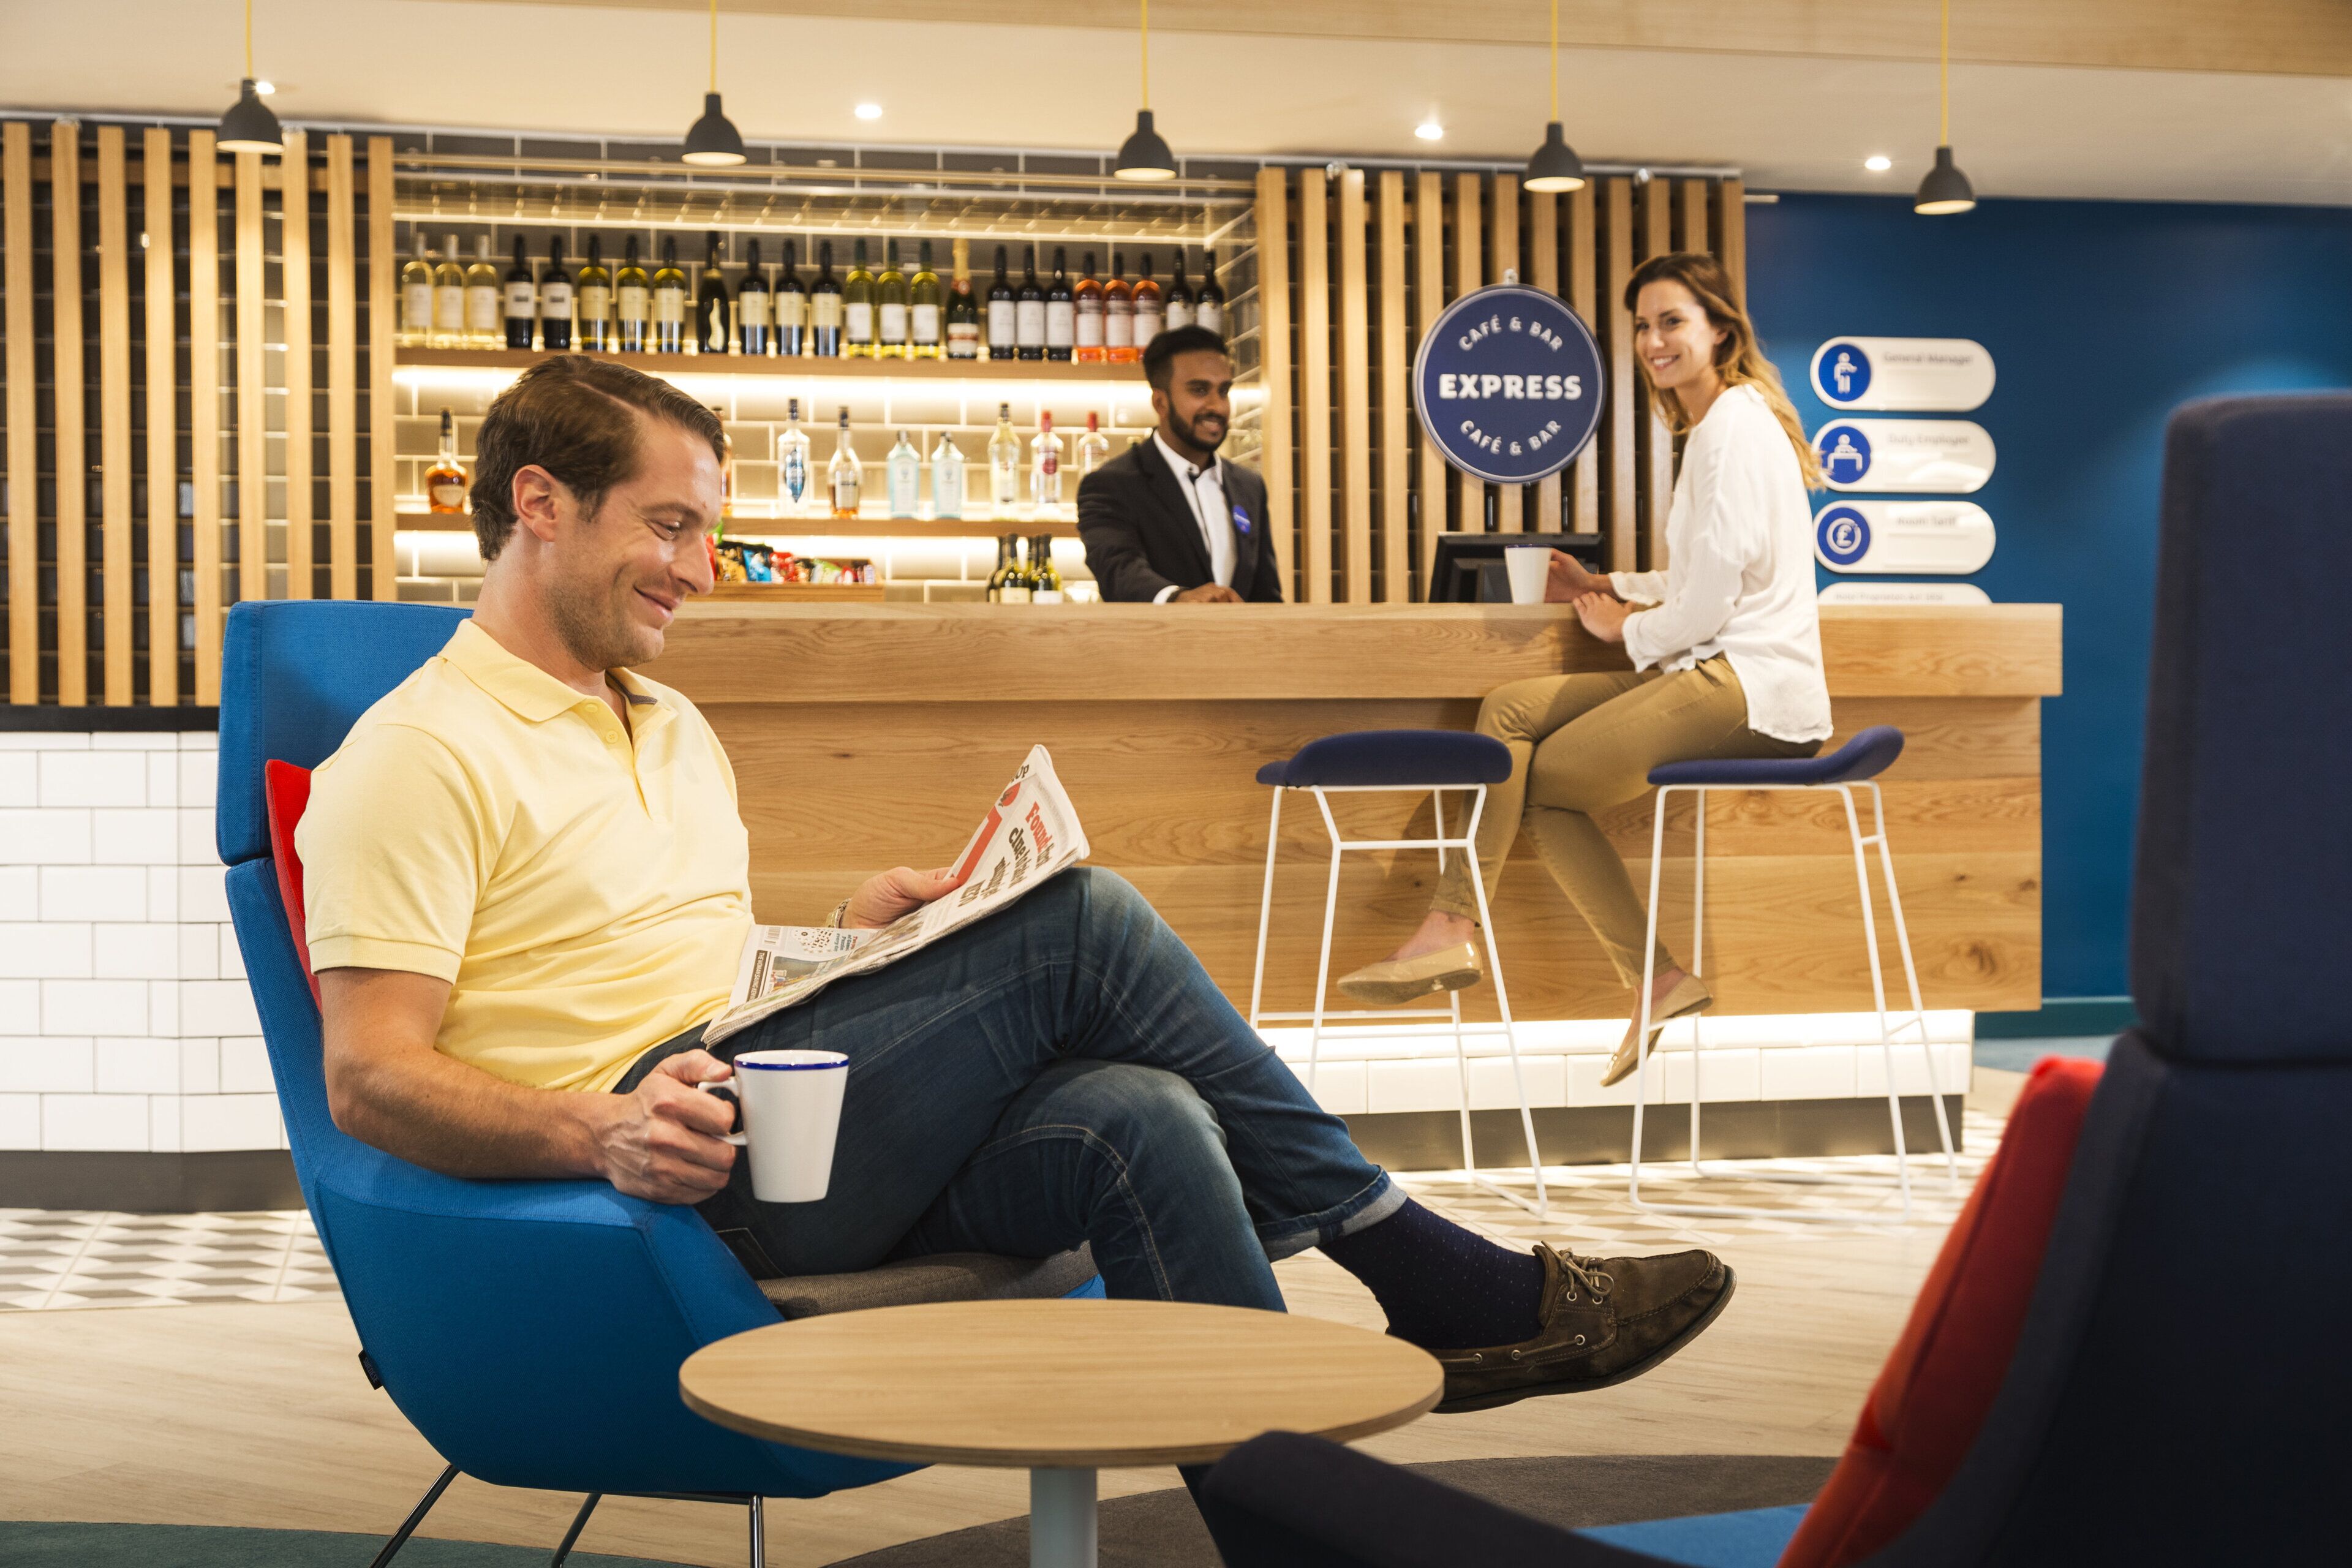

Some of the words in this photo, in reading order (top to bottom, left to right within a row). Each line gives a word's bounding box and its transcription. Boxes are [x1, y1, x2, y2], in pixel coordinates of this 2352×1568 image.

[1459, 314, 1502, 351] CAFÉ
[1509, 316, 1523, 333] &
[1529, 321, 1563, 352] BAR
[1883, 351, 1922, 363] General
[1927, 352, 1972, 366] Manager
[1439, 374, 1582, 400] EXPRESS
[1460, 420, 1502, 455] CAFÉ
[1509, 441, 1523, 456] &
[1528, 420, 1561, 451] BAR
[1008, 827, 1027, 861] clue
